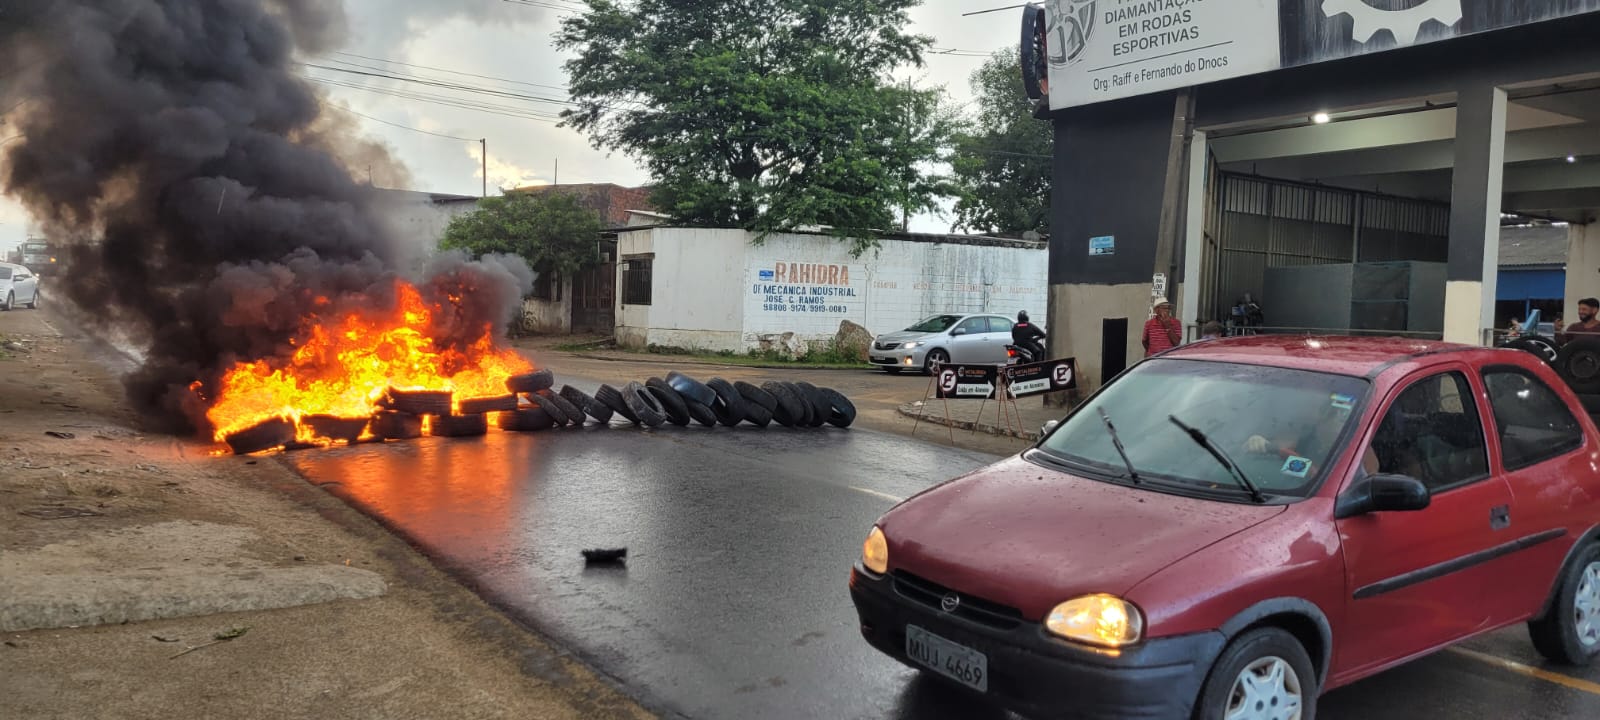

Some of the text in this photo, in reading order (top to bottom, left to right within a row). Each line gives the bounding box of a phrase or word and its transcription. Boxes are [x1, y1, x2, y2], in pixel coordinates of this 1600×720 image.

[1105, 0, 1202, 24] DIAMANTAÇ
[1119, 9, 1192, 38] EM RODAS
[1113, 26, 1199, 56] ESPORTIVAS
[1093, 56, 1229, 92] Org: Raiff e Fernando do Dnocs
[776, 262, 848, 285] RAHIDRA
[763, 285, 807, 296] MECANICA
[810, 287, 856, 297] INDUSTRIAL
[764, 295, 784, 304] JOSE
[799, 297, 825, 305] RAMOS
[946, 656, 982, 686] 4669
